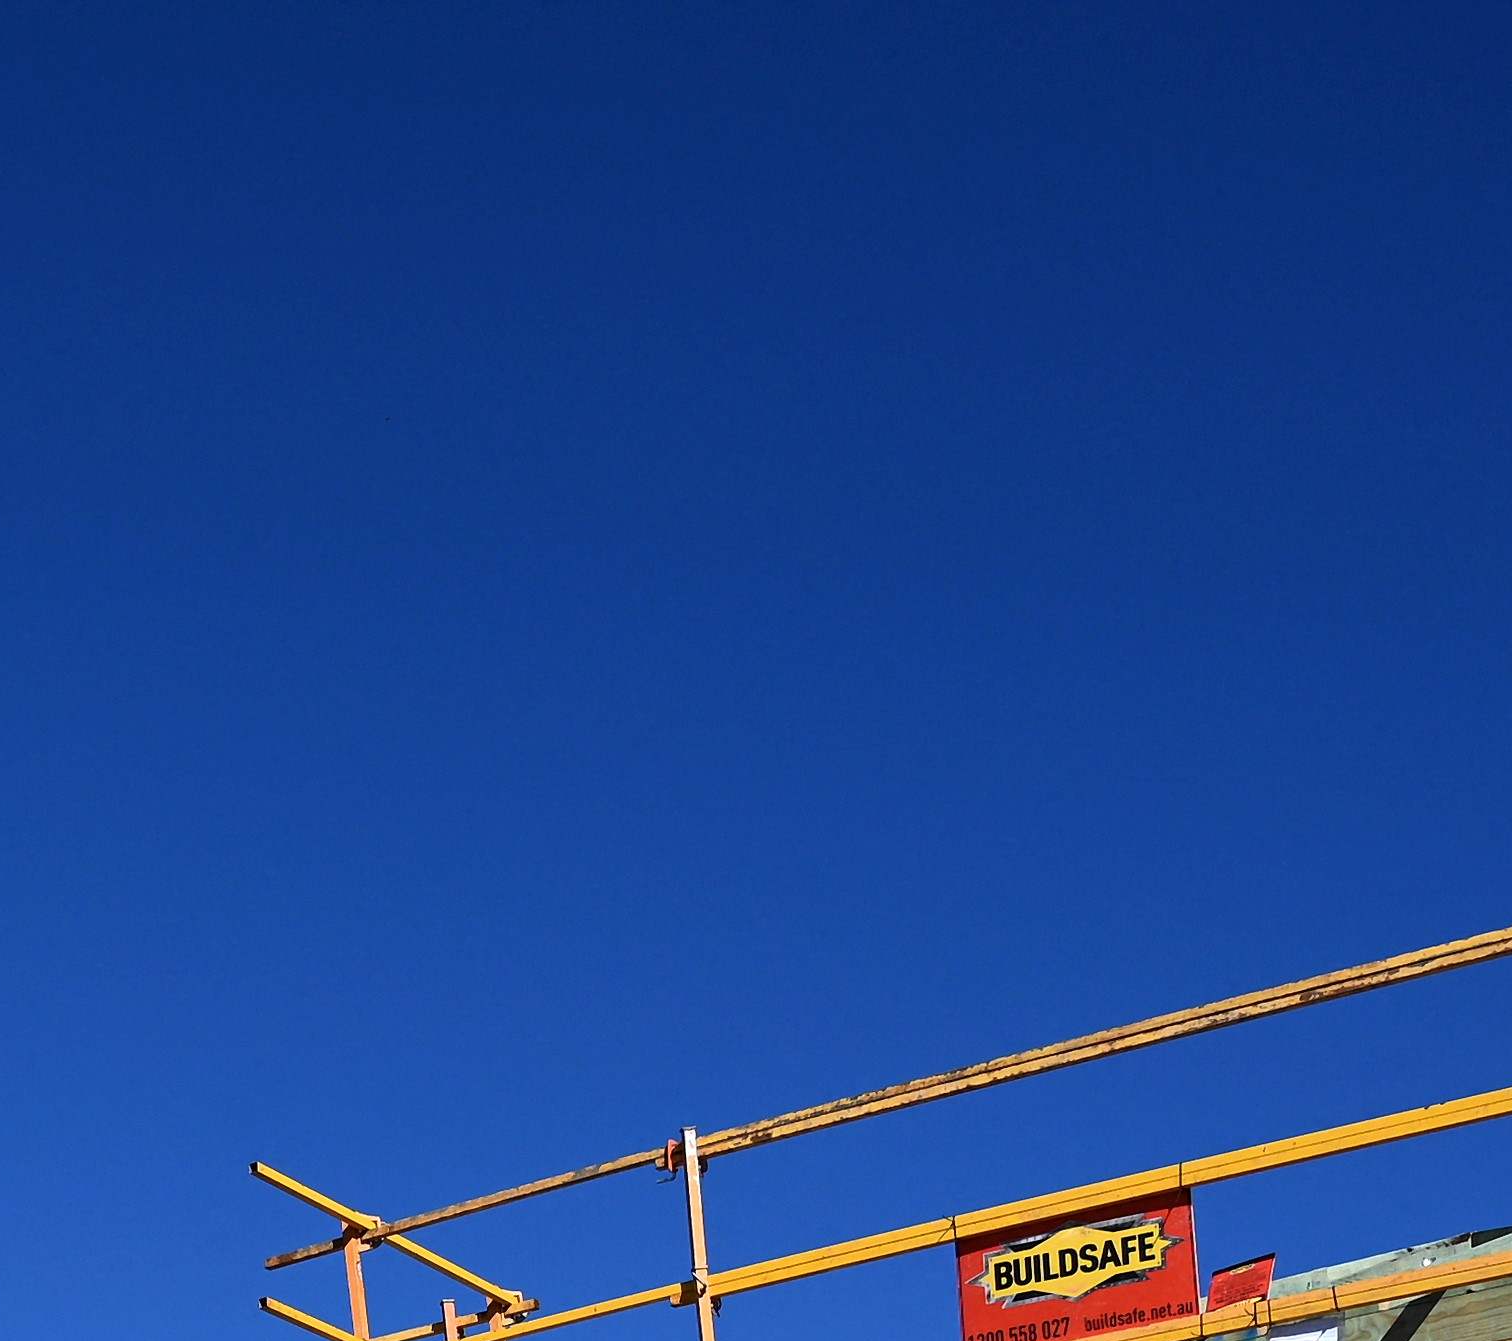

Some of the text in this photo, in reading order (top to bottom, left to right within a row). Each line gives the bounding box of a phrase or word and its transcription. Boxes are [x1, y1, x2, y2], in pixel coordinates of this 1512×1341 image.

[993, 1231, 1156, 1292] BUILDSAFE
[1041, 1316, 1070, 1340] 027
[1083, 1301, 1193, 1332] buildsafe.net.au
